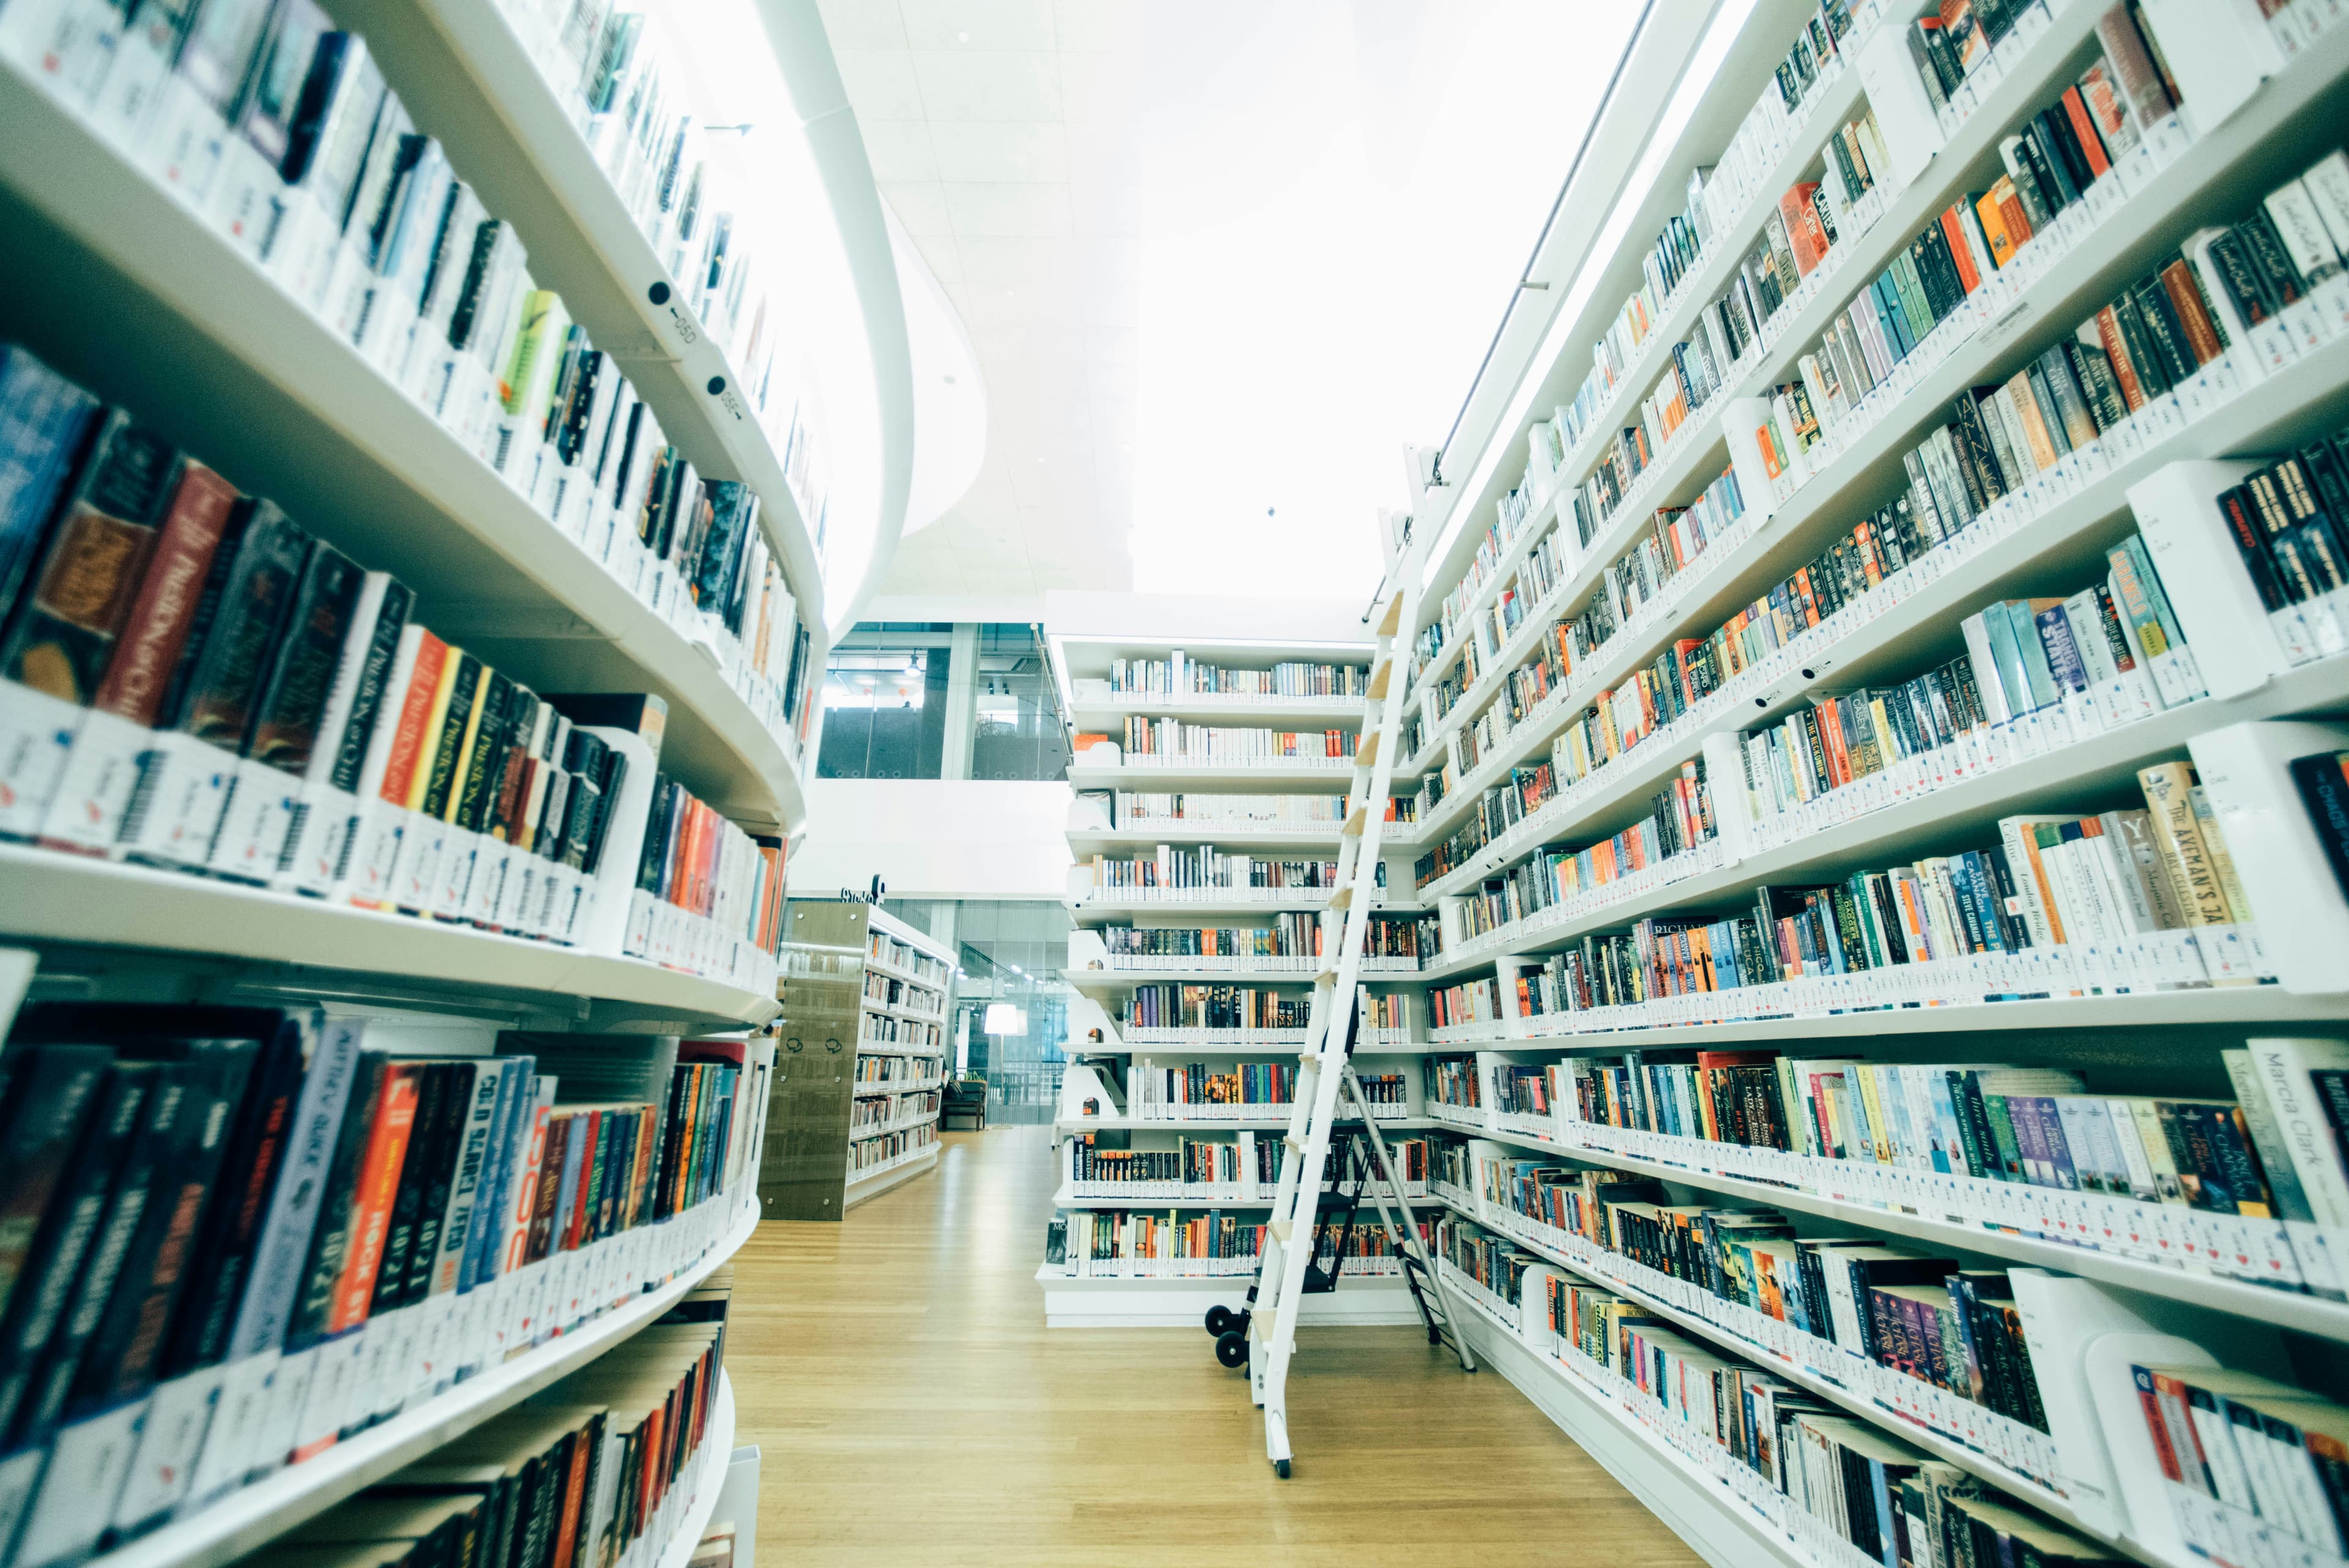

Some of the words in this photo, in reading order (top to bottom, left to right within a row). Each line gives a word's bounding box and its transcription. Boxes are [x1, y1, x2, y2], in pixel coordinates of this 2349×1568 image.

[675, 317, 696, 343] 05D
[1915, 477, 1933, 511] DARK
[1926, 510, 1943, 543] EDEN
[2109, 550, 2146, 616] CARAMELO
[2042, 625, 2067, 677] STATE
[2103, 610, 2120, 641] MURDER
[2113, 642, 2129, 665] ARTIST
[1699, 666, 1708, 688] CARD
[1853, 699, 1867, 730] CASEY
[1741, 741, 1753, 784] GEMINI
[1811, 737, 1825, 778] RECKONING
[2169, 798, 2187, 826] THE
[2165, 852, 2179, 870] RAY
[2175, 829, 2217, 901] AXEMAN'S
[1966, 861, 1986, 913] CAVANAGH
[1976, 871, 1988, 899] STEVE
[2171, 872, 2197, 919] CELESTIN
[1961, 894, 1973, 912] STEVE
[2020, 873, 2035, 908] London
[2032, 910, 2046, 941] Bridge
[1965, 911, 1982, 943] CAVANAGH
[1984, 920, 1997, 940] THE
[1754, 945, 1765, 972] NICO
[1745, 1086, 1755, 1110] LADY
[1756, 1086, 1764, 1110] LADY
[2265, 1052, 2298, 1115] Marcia
[2294, 1120, 2323, 1166] Clark
[1952, 1083, 1964, 1117] DRAGON
[1961, 1118, 1974, 1154] SPRINGS
[1969, 1153, 1979, 1176] ROAD
[1980, 1130, 1994, 1163] souls
[1852, 1278, 1860, 1299] TIDE
[1857, 1303, 1870, 1348] WATCHERS
[1948, 1296, 1962, 1326] Wink
